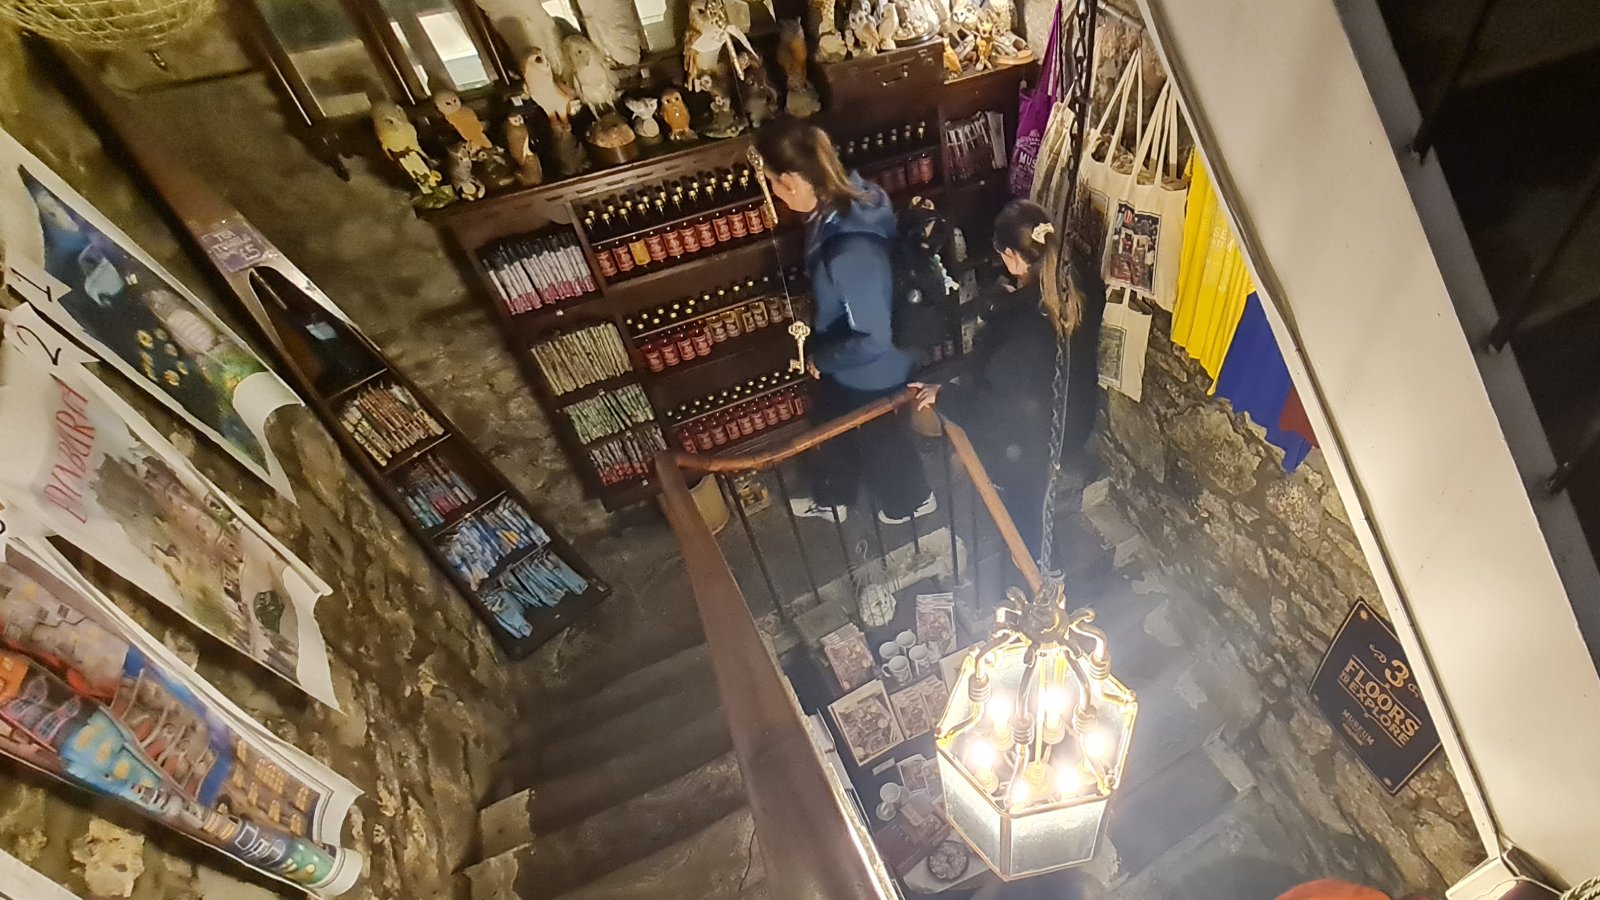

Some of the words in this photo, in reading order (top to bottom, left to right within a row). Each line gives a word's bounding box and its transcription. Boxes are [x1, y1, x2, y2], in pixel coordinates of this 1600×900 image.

[16, 324, 62, 366] 2
[1344, 658, 1420, 737] FLOORS
[1384, 659, 1410, 688] 3
[1348, 680, 1411, 746] EXPLORE
